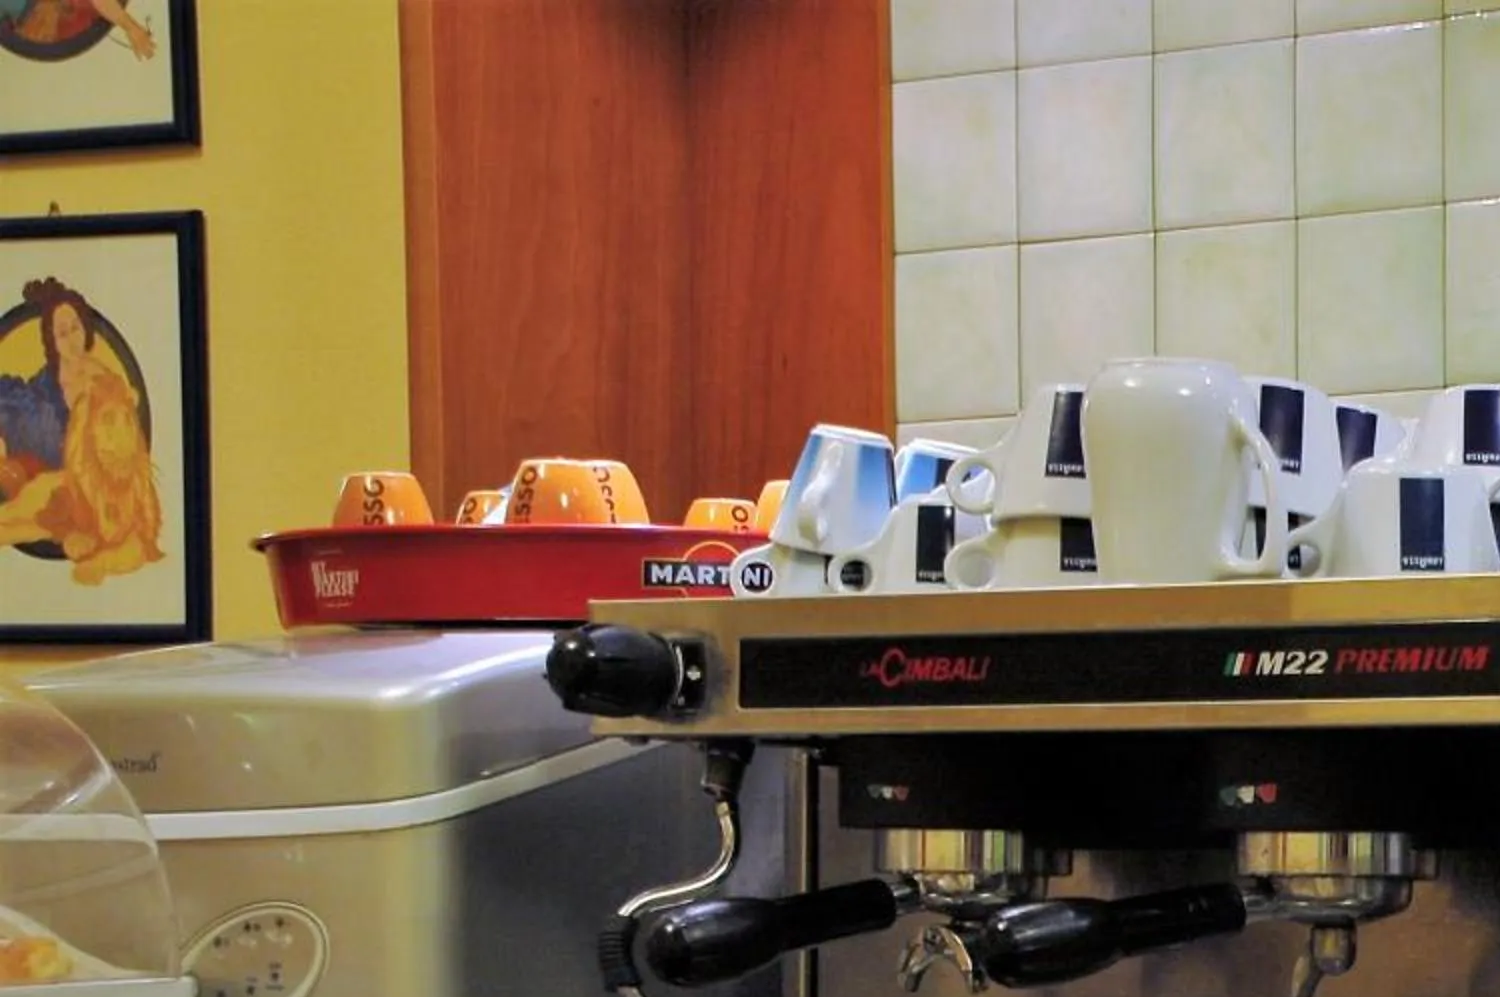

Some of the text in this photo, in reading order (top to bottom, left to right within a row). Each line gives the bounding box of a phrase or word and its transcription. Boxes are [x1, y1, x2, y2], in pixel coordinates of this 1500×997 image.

[651, 563, 771, 587] MARTNI
[1255, 646, 1490, 676] M22 PREMIUM
